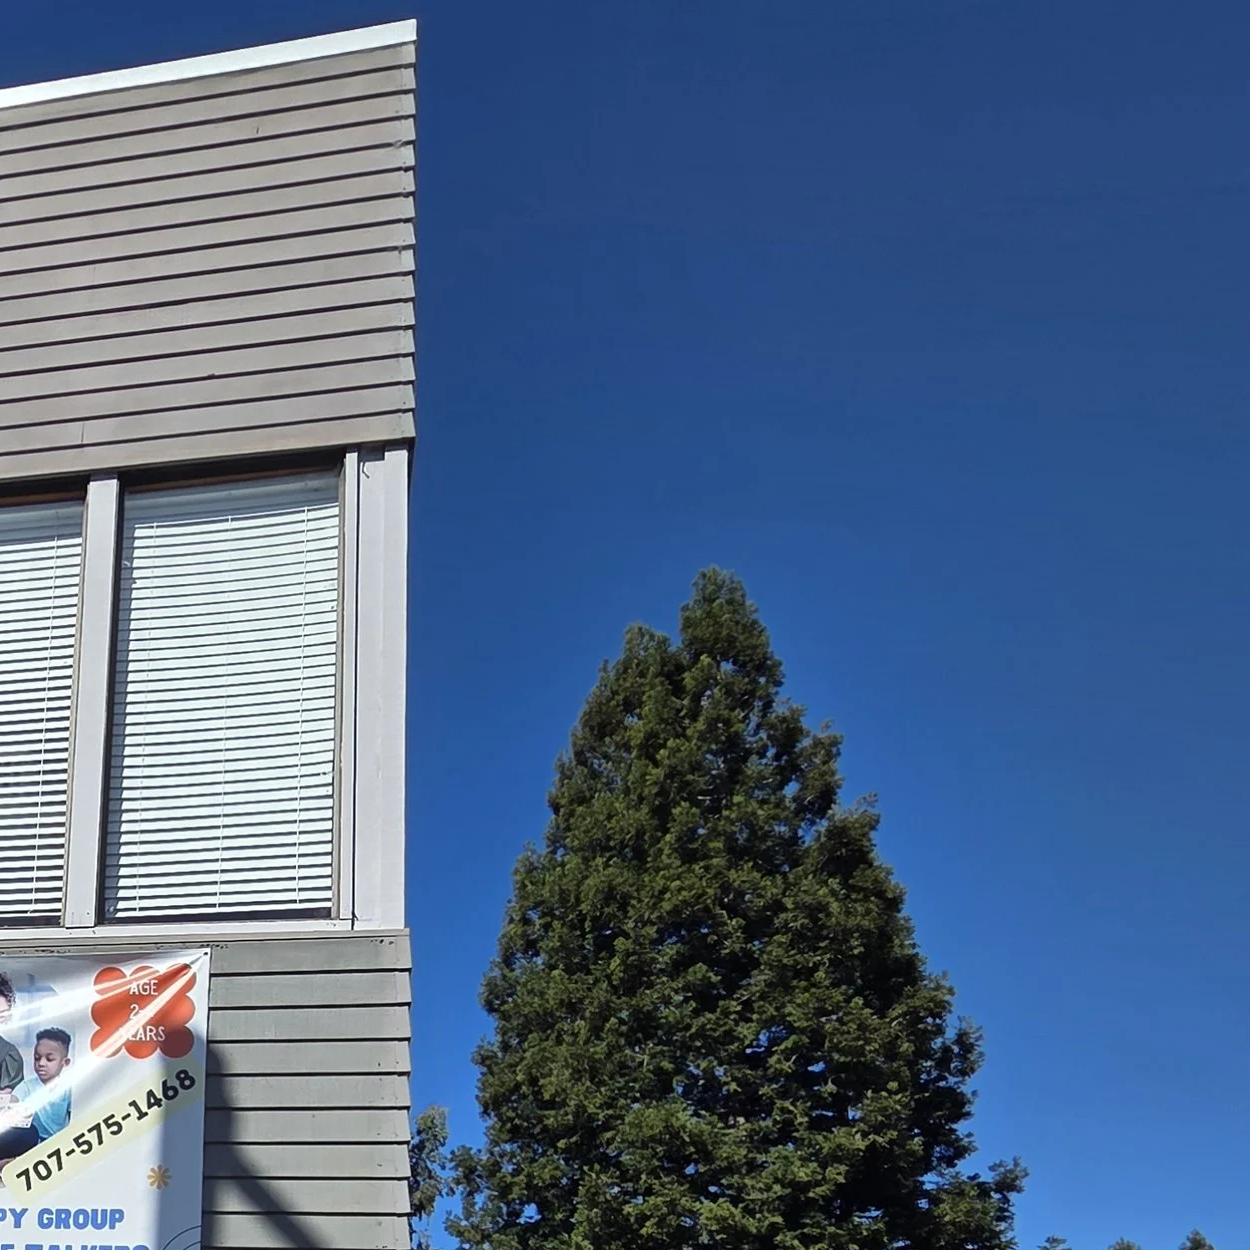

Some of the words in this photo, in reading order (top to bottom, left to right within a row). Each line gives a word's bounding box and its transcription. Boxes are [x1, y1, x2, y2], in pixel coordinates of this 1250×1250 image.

[130, 980, 158, 995] AGE
[15, 1069, 196, 1192] 707-575-1468
[37, 1208, 125, 1230] GROUP
